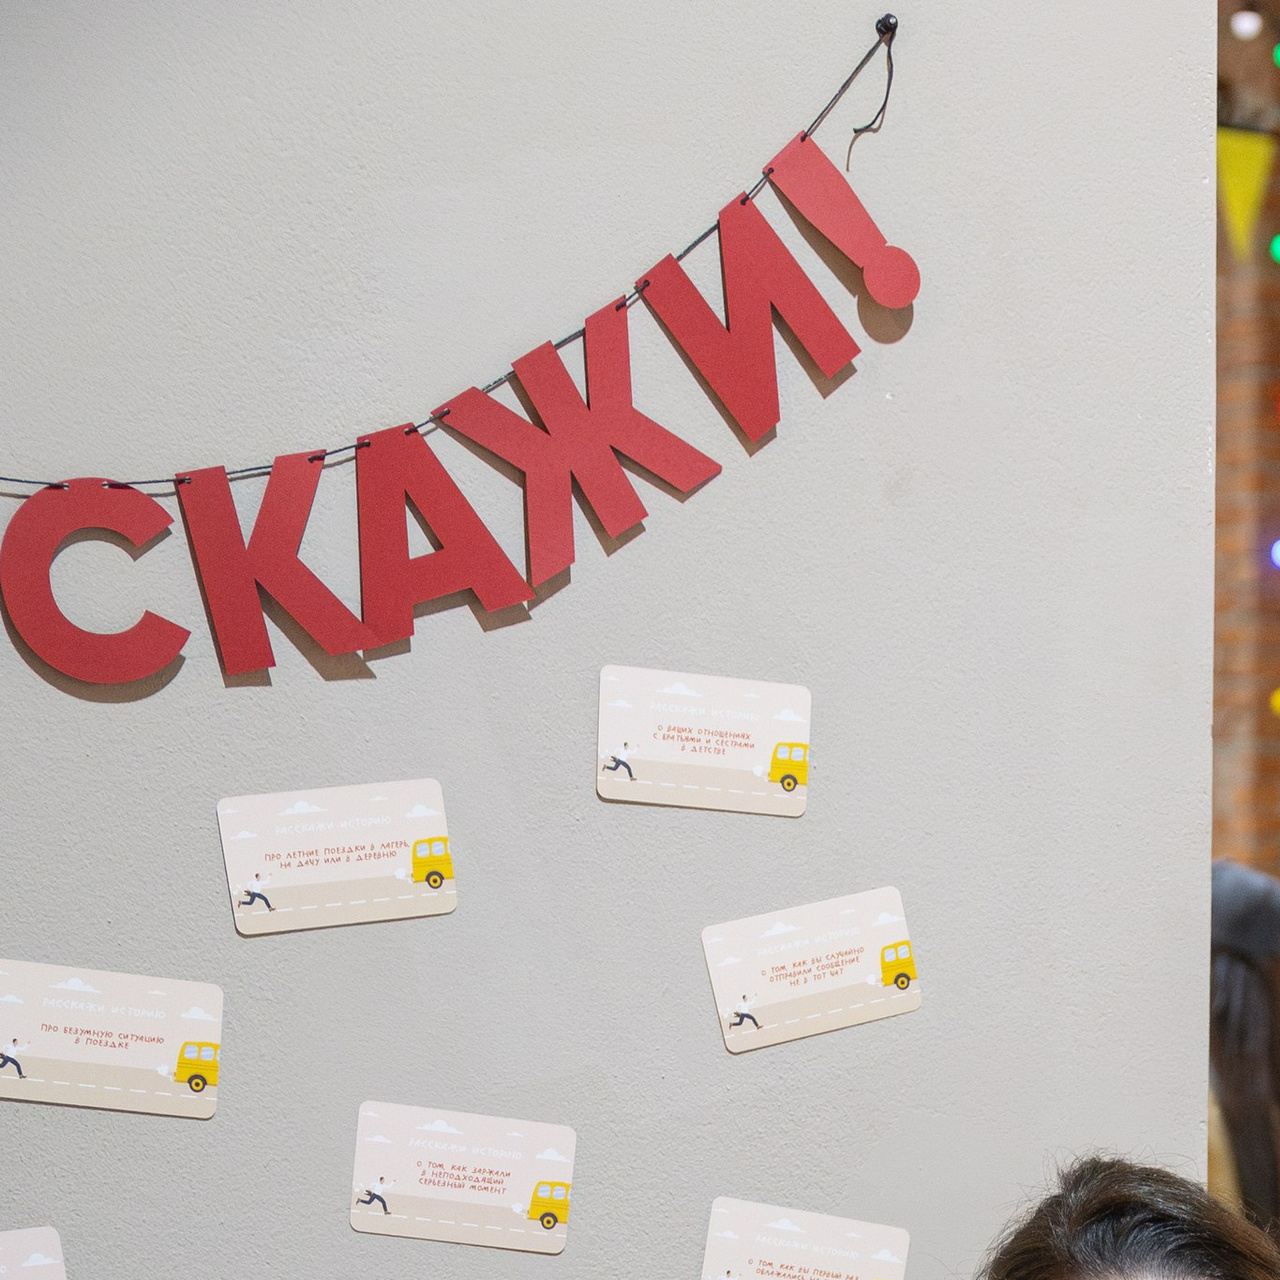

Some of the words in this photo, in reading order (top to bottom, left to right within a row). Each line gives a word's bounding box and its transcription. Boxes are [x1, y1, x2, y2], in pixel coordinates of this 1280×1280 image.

[0, 131, 921, 684] СКАЖИ!
[667, 726, 693, 734] ВАШИХ
[698, 728, 750, 740] ОТНОШЕНИЯХ
[662, 734, 701, 743] БРАТЬЯМИ
[715, 739, 755, 748] СЕСТРАМИ
[691, 746, 726, 755] ДЕТСТВЕ
[275, 821, 334, 835] РАССКАЖИ
[265, 853, 281, 862] ПРО
[286, 850, 319, 859] ЛЕТНИЕ
[324, 845, 366, 855] ПОЕЗДКИ
[280, 861, 291, 869] НА
[297, 858, 320, 868] ДАЧУ
[324, 856, 341, 864] ИЛИ
[356, 851, 397, 861] ДЕРЕВНЮ
[793, 960, 807, 968] КАК
[811, 957, 822, 965] ВЫ
[826, 946, 864, 960] СЛУЧАЙНО
[770, 969, 812, 982] ОТПРАВИЛИ
[816, 957, 860, 971] СООБЩЕНИЕ
[790, 979, 800, 987] НЕ
[814, 973, 827, 981] ТОТ
[830, 969, 844, 977] ЧАТ
[41, 1024, 58, 1032] ПРО
[63, 1027, 113, 1039] БЕЗУМНУЮ
[118, 1033, 164, 1044] СИТУАЦИЮ
[86, 1038, 129, 1049] ПОЕЗДКЕ
[409, 1138, 466, 1152] РАССКАЖИ
[431, 1171, 504, 1185] НЕПОДХОДЯЩИЙ
[472, 1167, 511, 1177] ЗАРЖАЛИ
[419, 1178, 465, 1189] СЕРЬЕЗНЫЙ
[469, 1184, 506, 1194] МОМЕНТ
[813, 1269, 841, 1279] ПЕРВЫЙ
